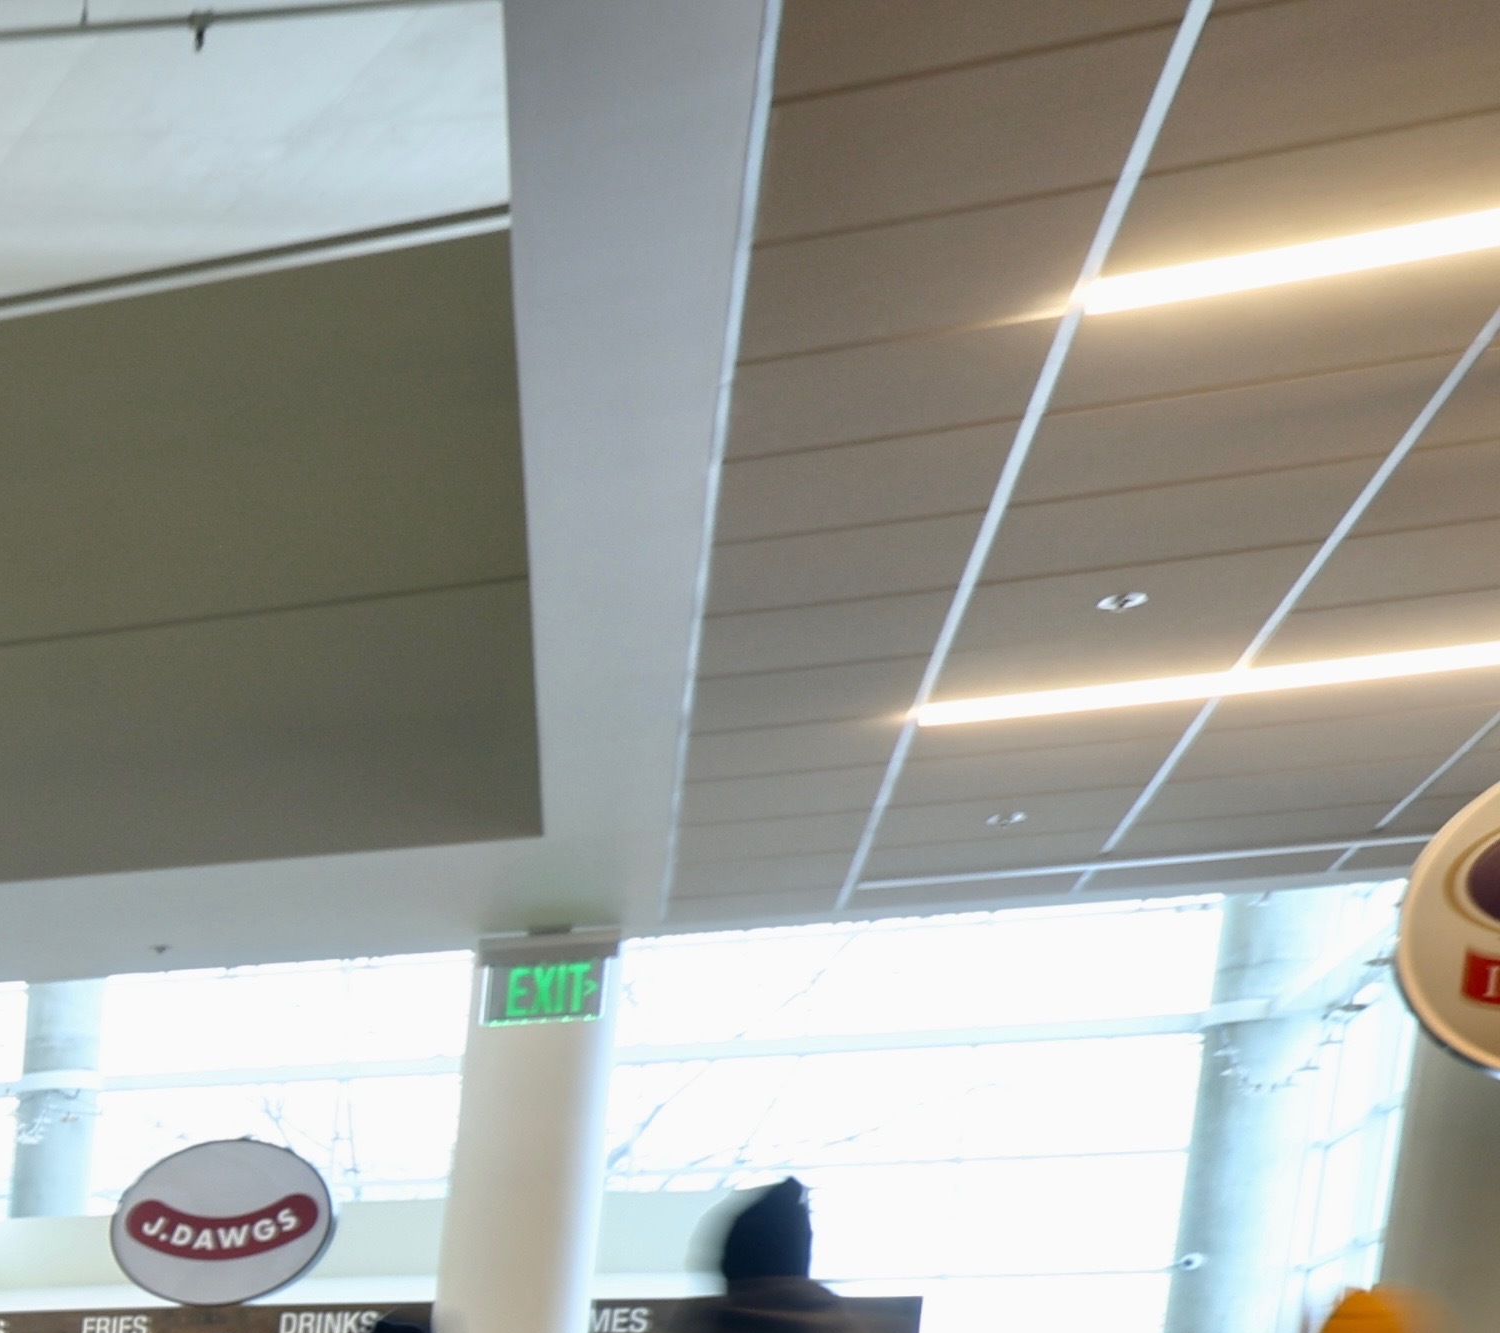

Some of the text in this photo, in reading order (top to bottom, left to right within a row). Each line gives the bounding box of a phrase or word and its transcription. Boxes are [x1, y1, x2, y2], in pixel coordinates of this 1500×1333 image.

[506, 962, 591, 1016] EXIT
[142, 1208, 299, 1251] J.DAWGS
[590, 1307, 649, 1333] MES
